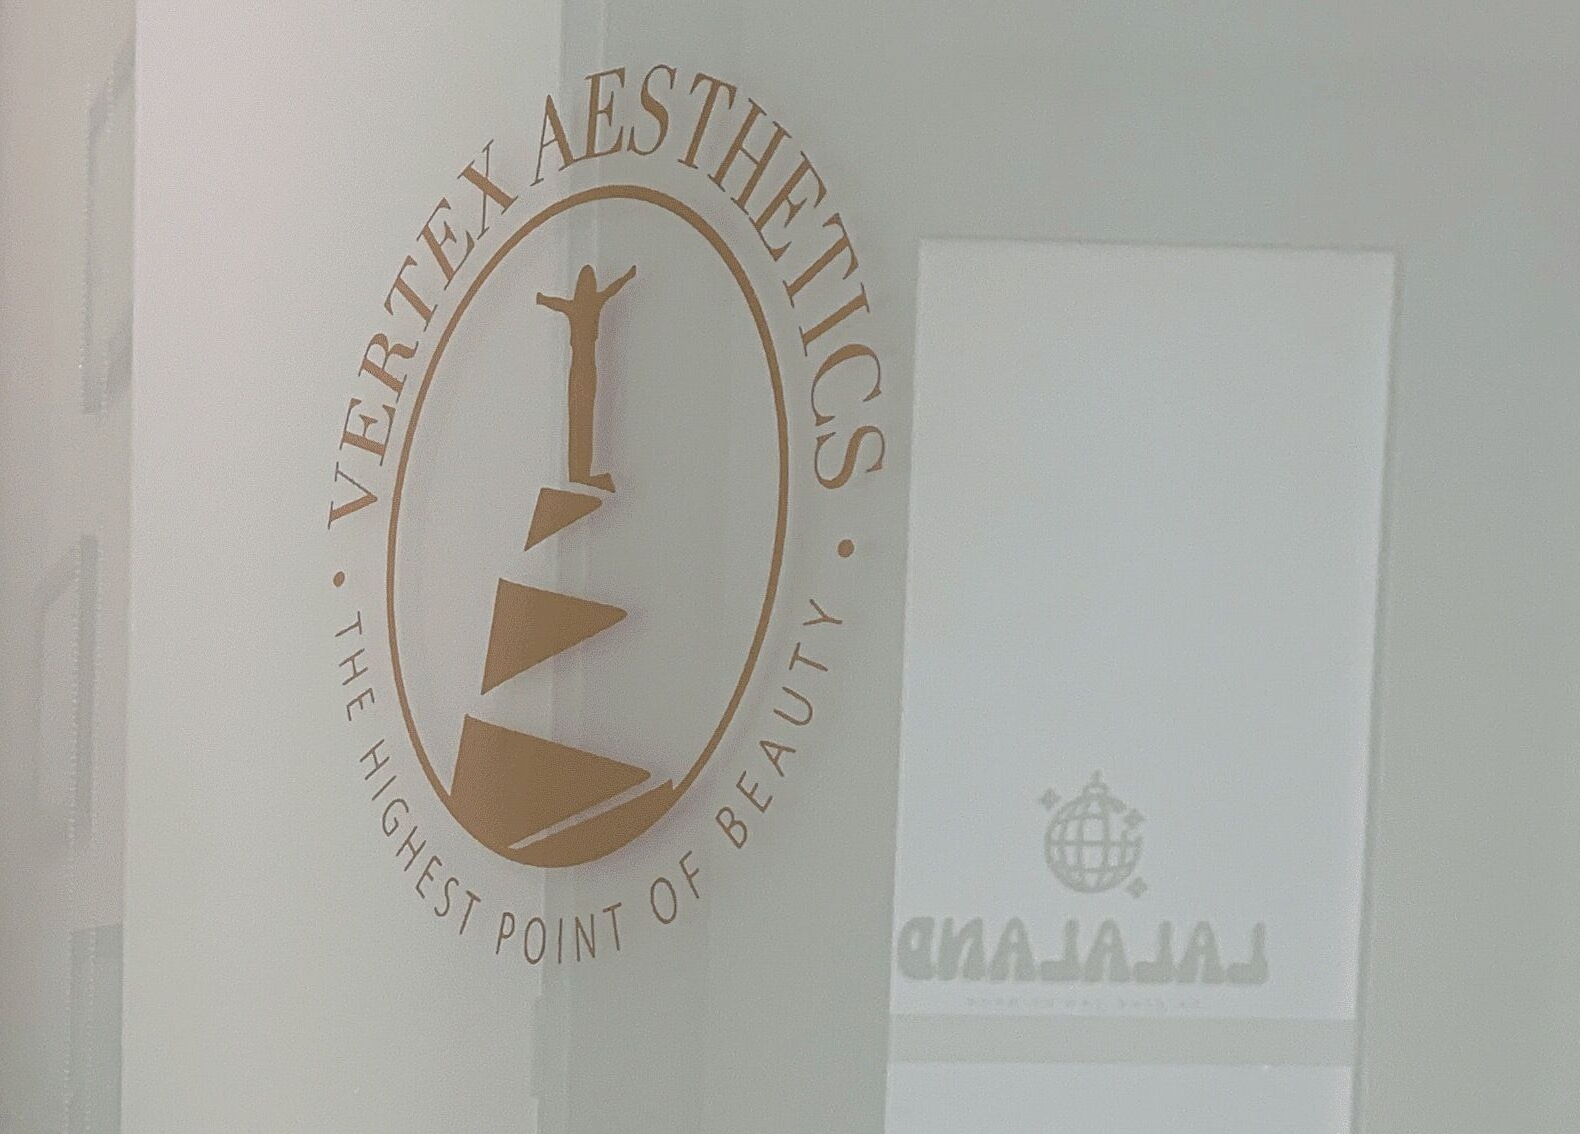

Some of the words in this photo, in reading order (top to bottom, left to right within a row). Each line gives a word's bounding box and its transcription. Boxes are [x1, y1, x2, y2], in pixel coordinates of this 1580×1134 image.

[327, 140, 519, 529] VERTEX
[530, 63, 887, 491] AESTHETICS
[333, 611, 376, 721] THE
[359, 738, 481, 936] HIGHEST
[496, 901, 622, 966] POINT
[650, 850, 704, 925] OF
[716, 599, 845, 849] BEAUTY
